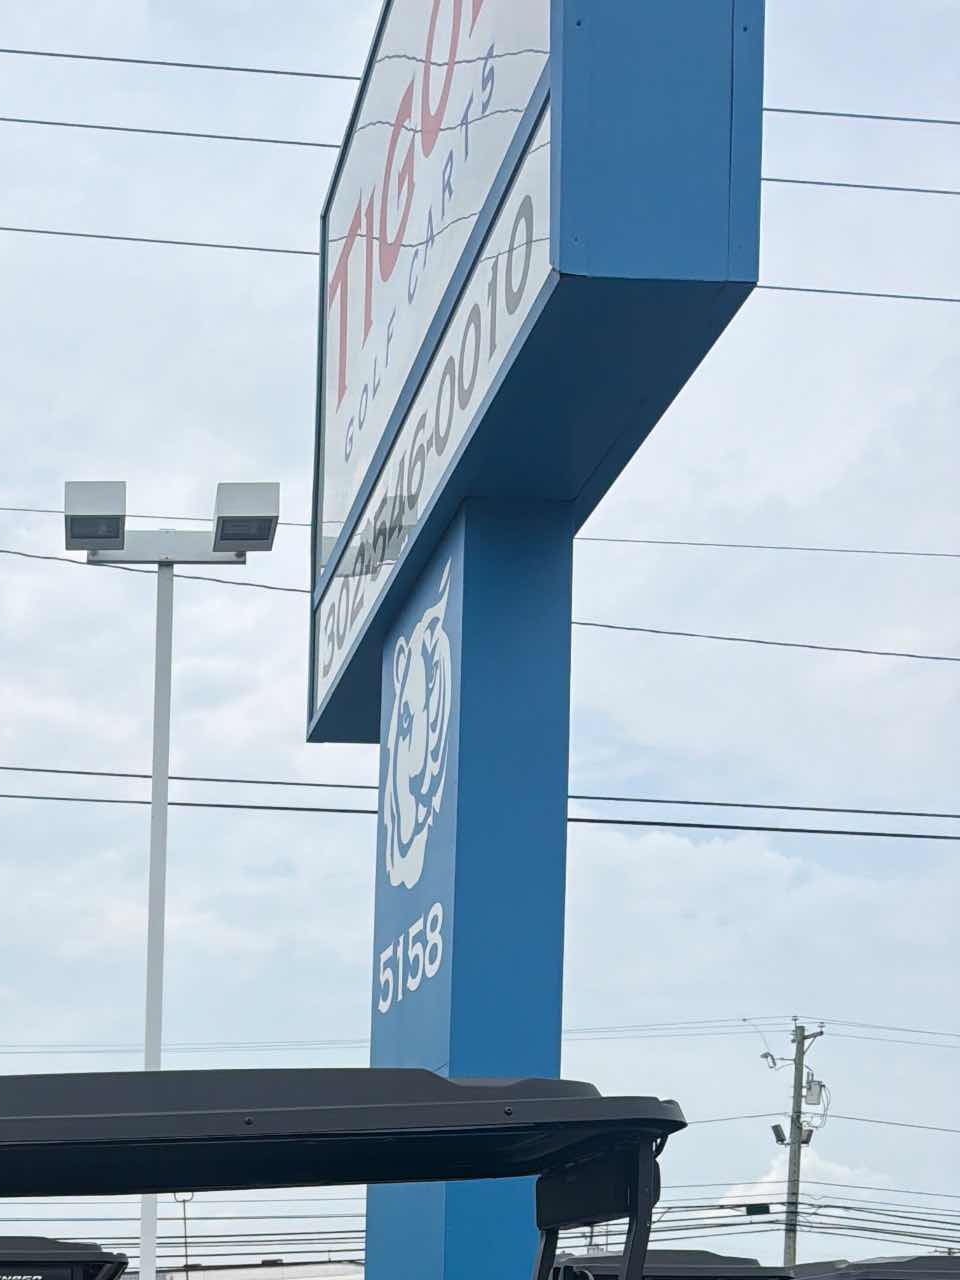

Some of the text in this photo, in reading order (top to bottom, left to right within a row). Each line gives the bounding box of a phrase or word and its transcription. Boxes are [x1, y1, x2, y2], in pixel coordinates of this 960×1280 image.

[327, 0, 485, 415] TIGO
[344, 40, 495, 464] GOLF CARTS
[377, 902, 443, 1014] 5158
